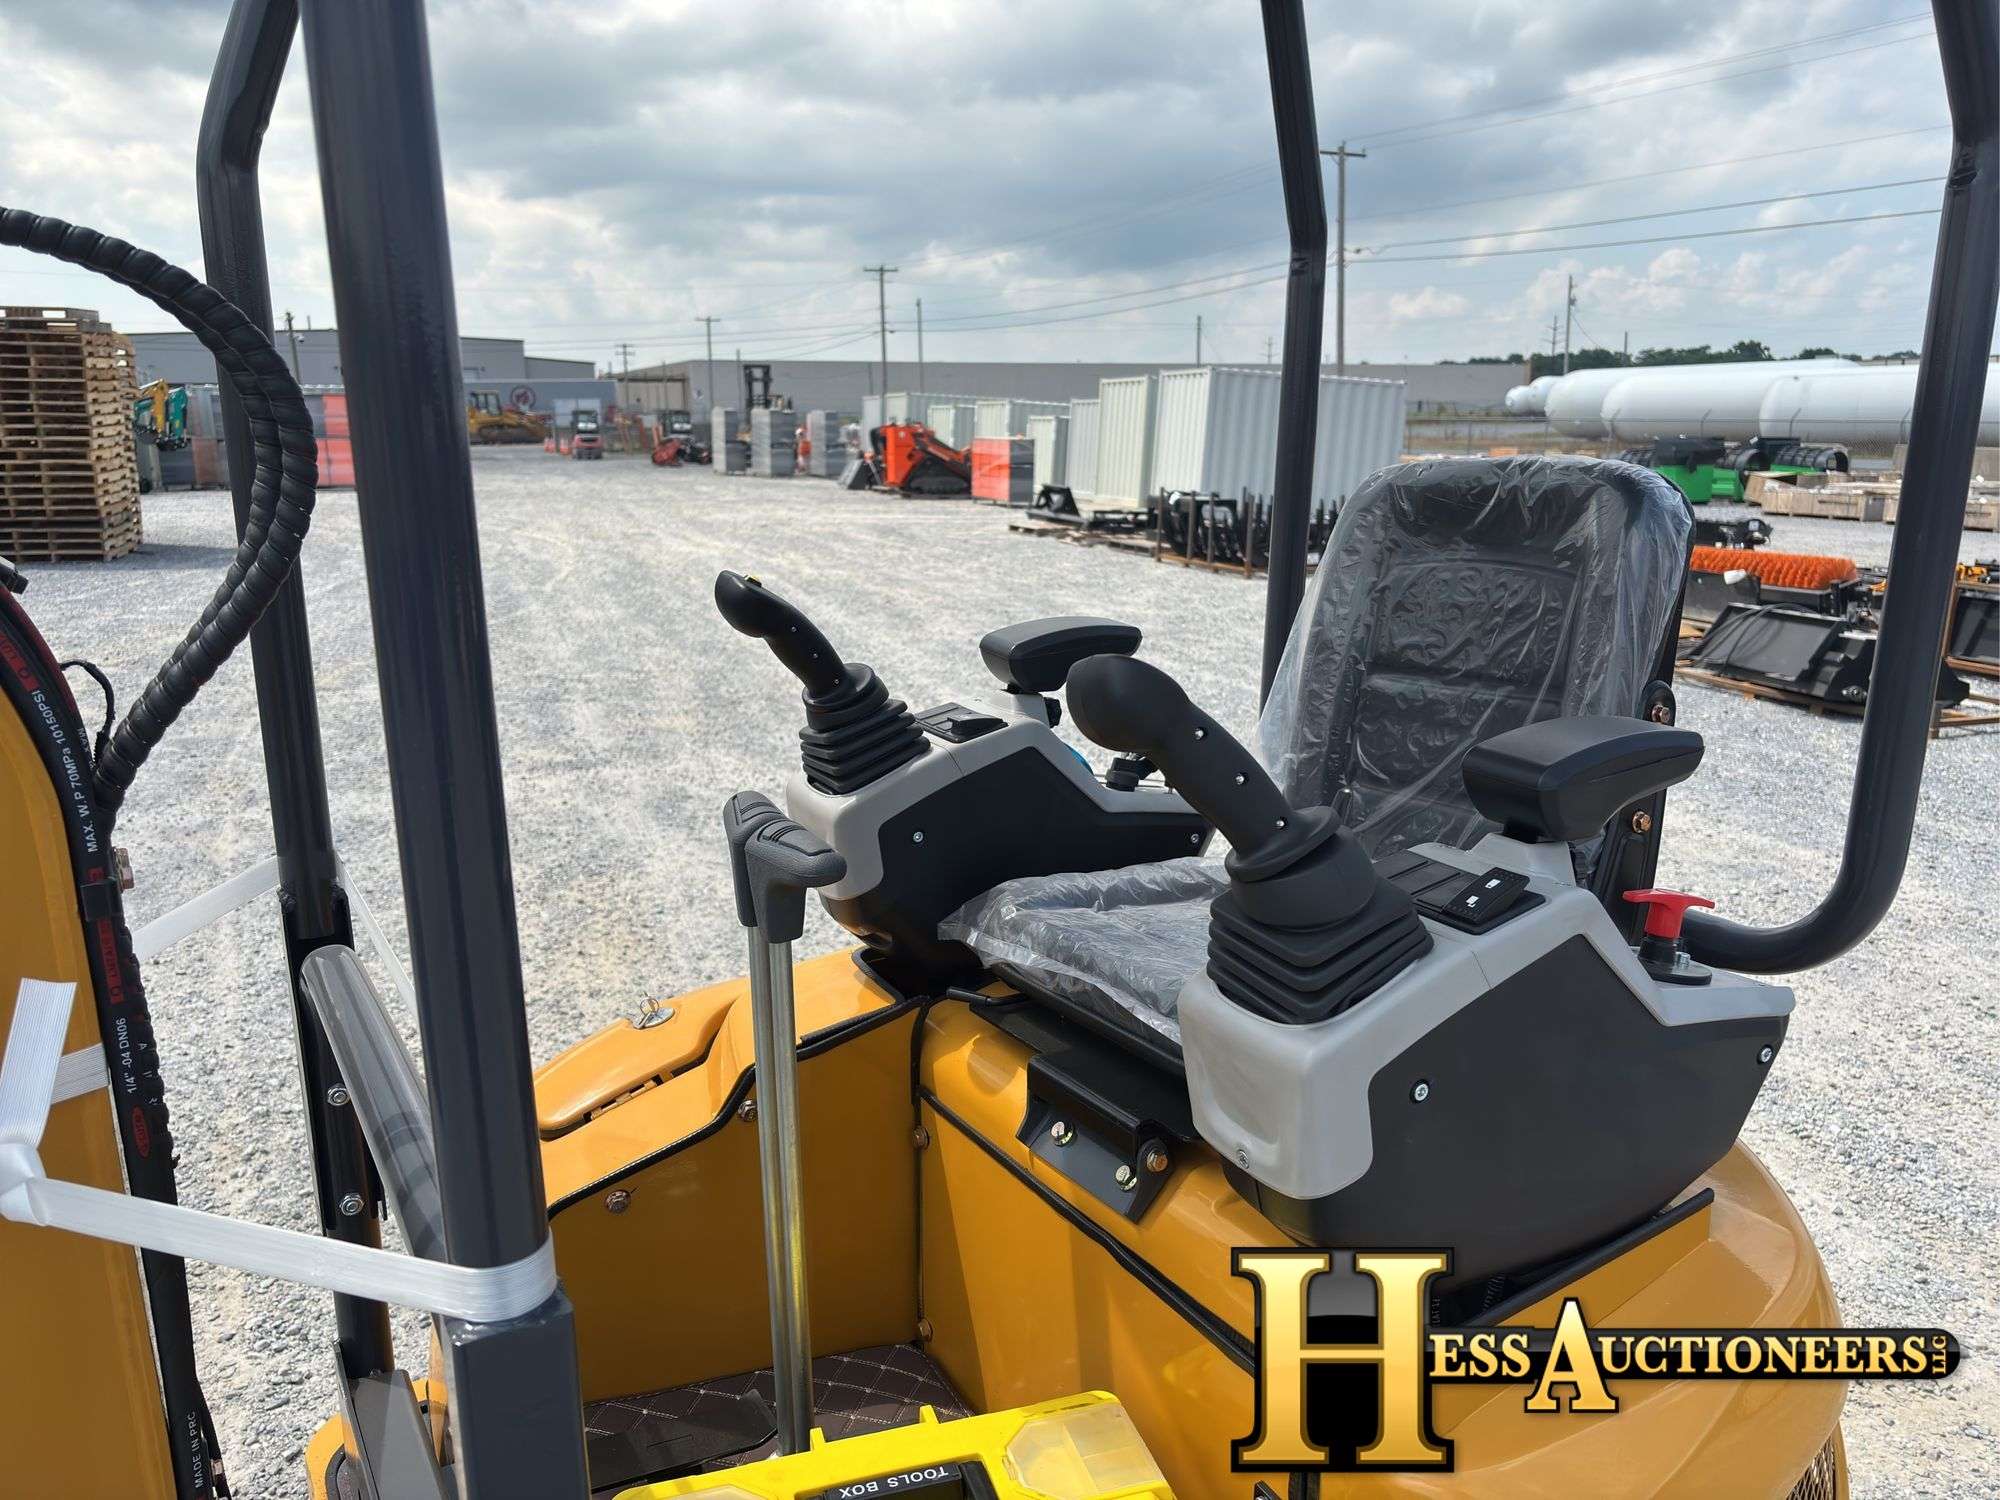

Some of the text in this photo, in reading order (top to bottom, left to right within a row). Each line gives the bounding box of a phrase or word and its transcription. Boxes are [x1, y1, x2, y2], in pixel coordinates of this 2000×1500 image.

[31, 690, 66, 745] 10150PSI
[62, 746, 82, 789] 70MPa
[116, 1017, 130, 1049] DN06
[187, 1411, 204, 1489] MADE IN PRC
[839, 1466, 949, 1499] TOOLS BOX
